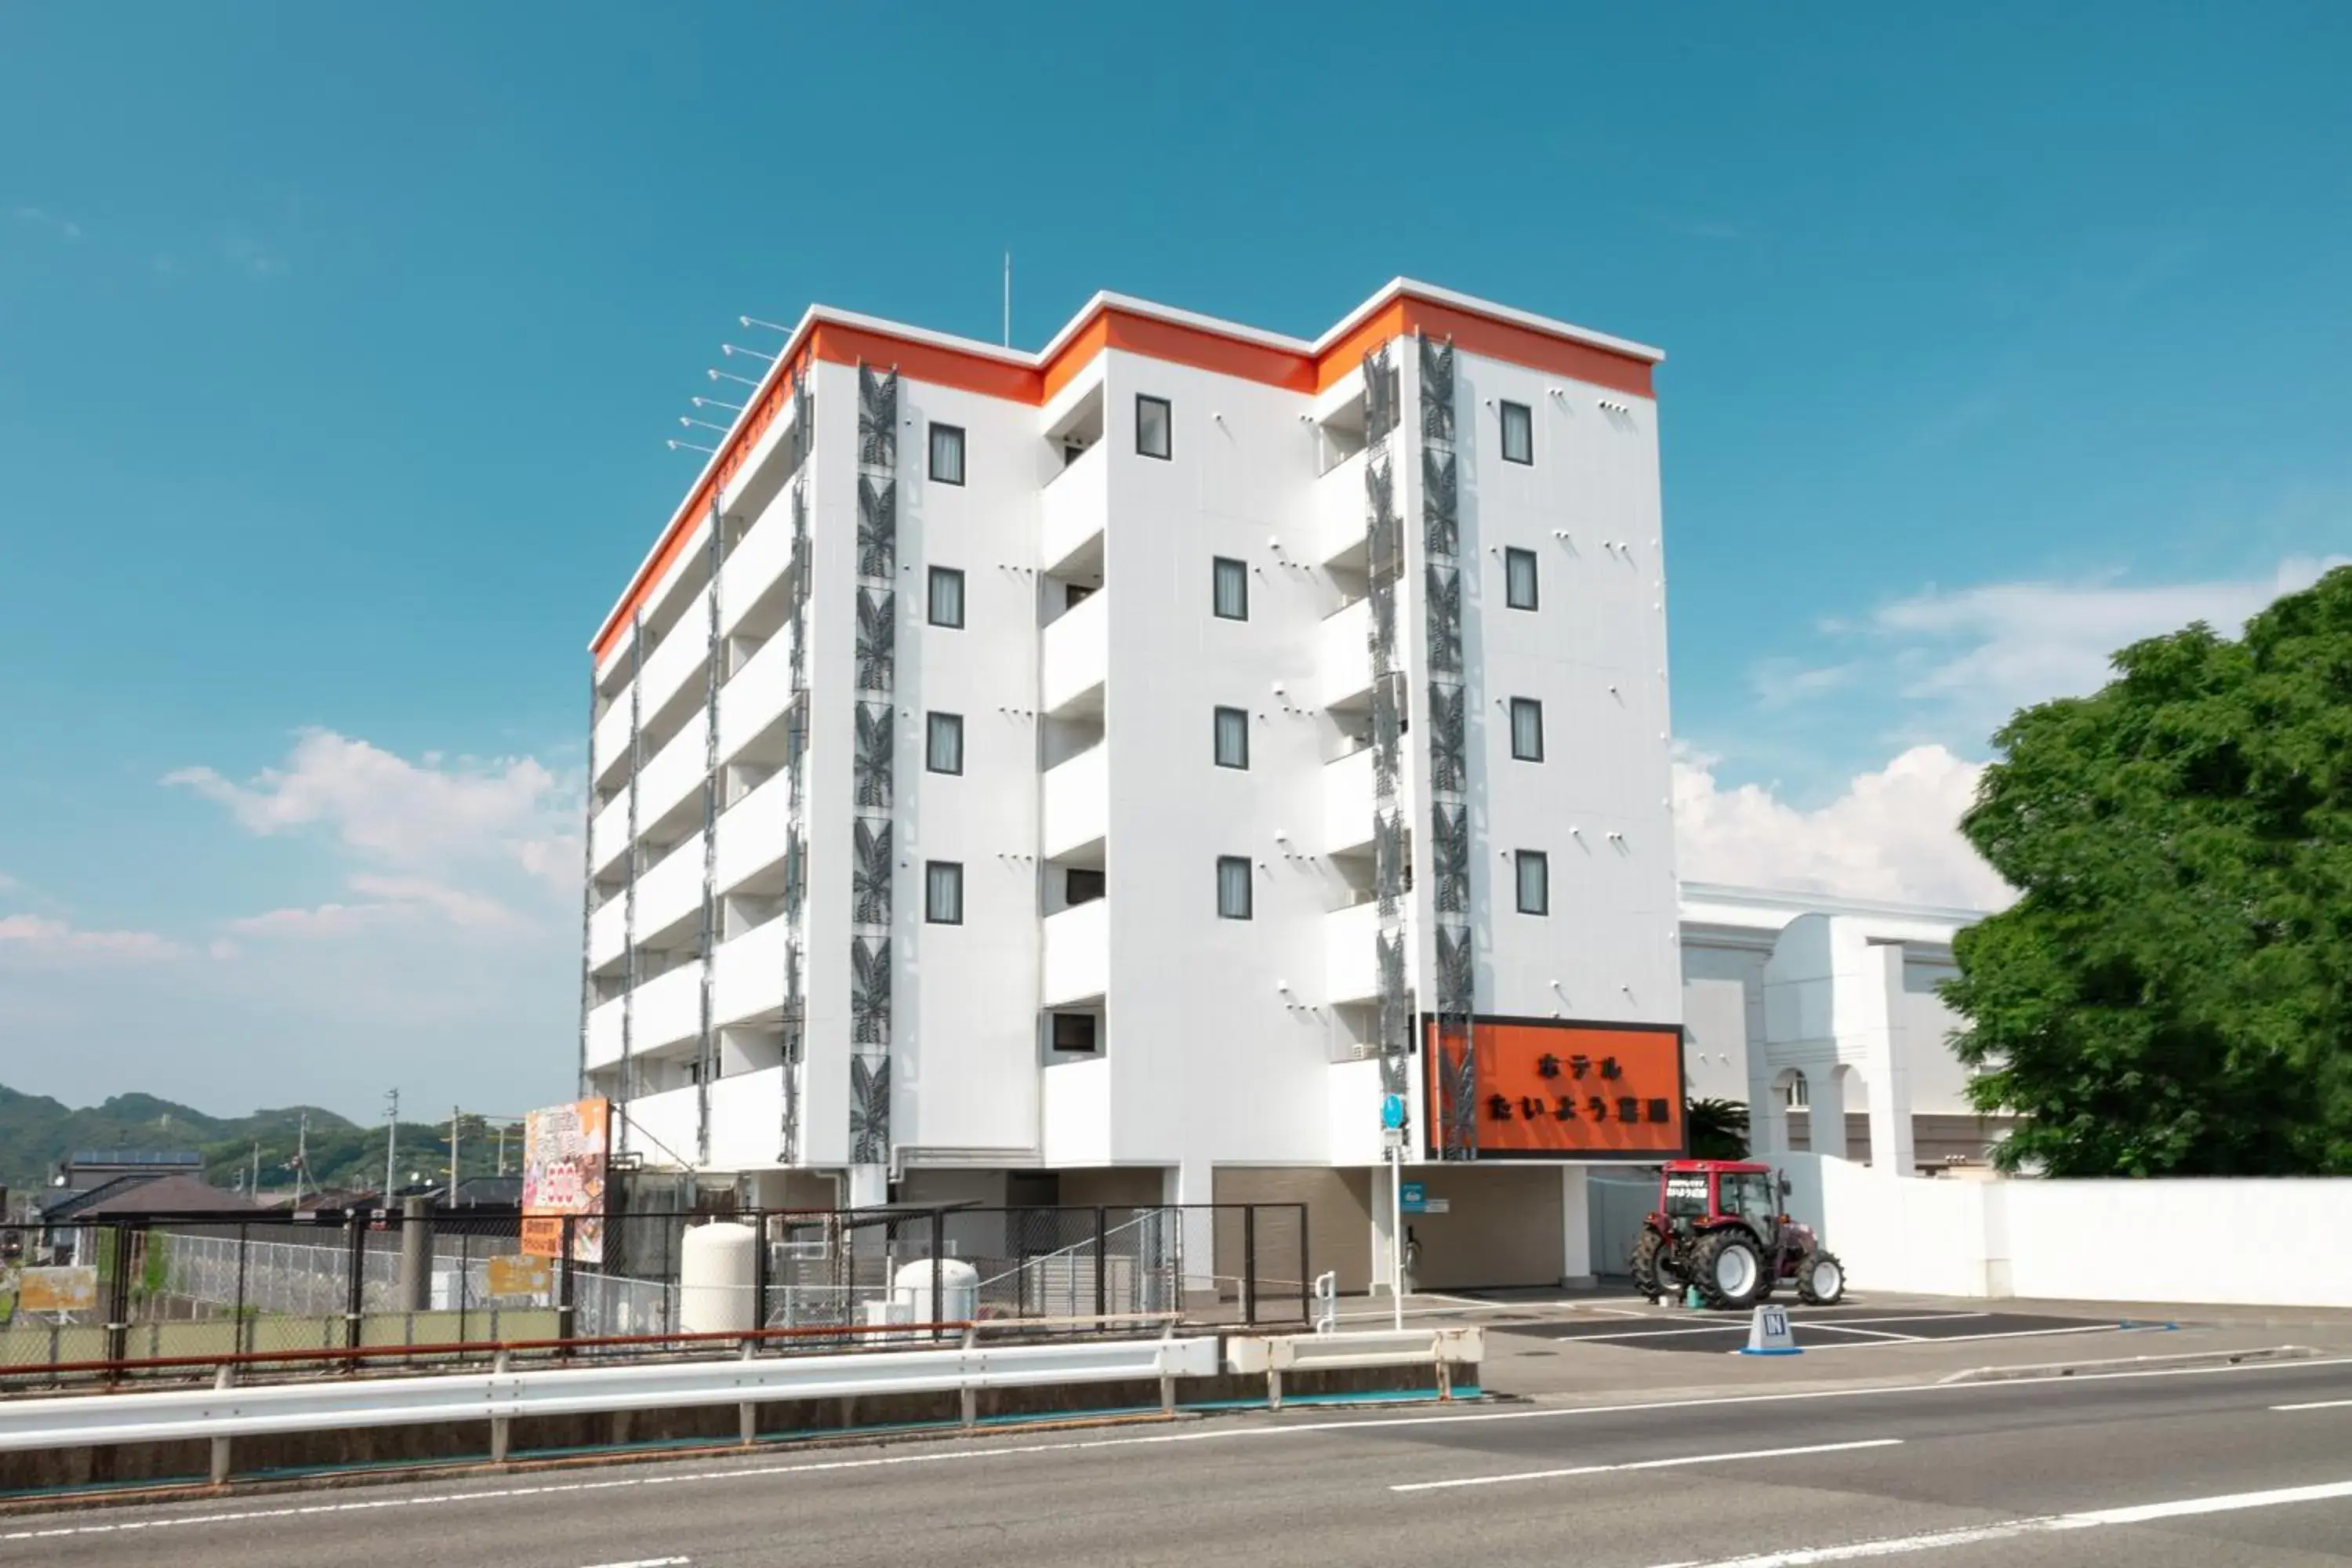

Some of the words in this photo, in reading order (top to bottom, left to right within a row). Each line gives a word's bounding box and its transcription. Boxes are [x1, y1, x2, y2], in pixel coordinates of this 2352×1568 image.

[1537, 1054, 1622, 1080] ホテル
[1763, 1313, 1786, 1336] IN
